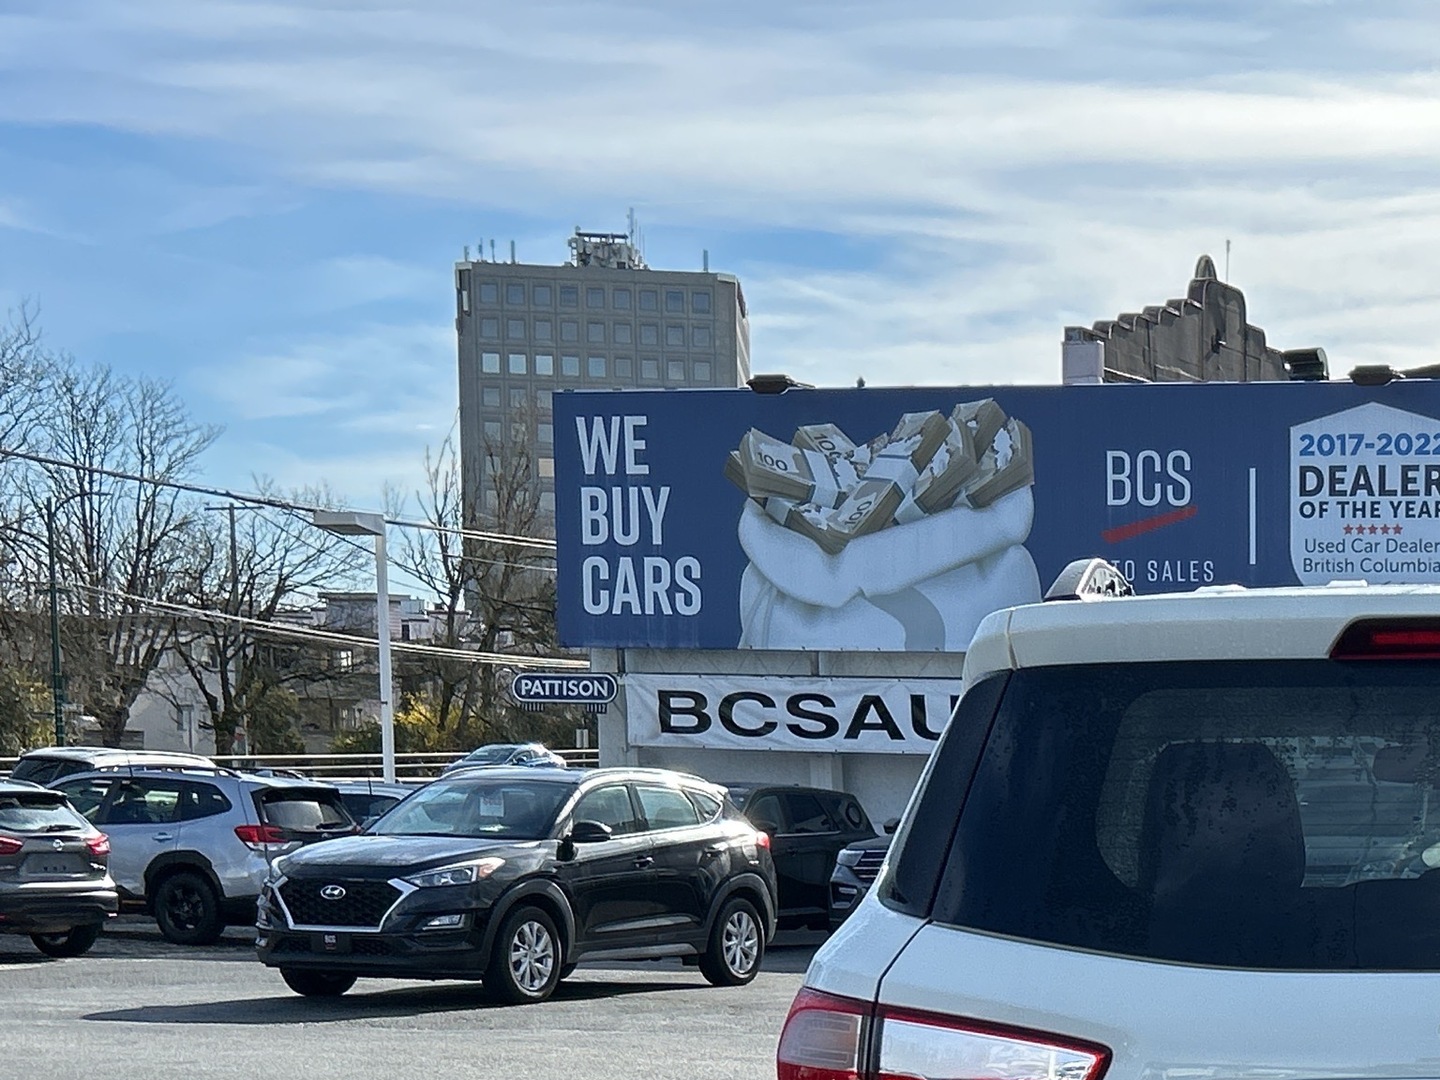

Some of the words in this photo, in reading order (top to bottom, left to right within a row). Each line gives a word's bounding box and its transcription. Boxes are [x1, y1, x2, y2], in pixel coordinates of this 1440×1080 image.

[575, 415, 649, 475] WE
[756, 450, 789, 472] 100
[1106, 449, 1192, 507] BCS
[580, 486, 671, 545] BUY
[844, 500, 873, 526] 100
[1299, 501, 1329, 519] OF
[1336, 501, 1381, 519] THE
[1304, 537, 1346, 554] Used
[1351, 537, 1381, 554] Car
[1386, 537, 1440, 554] Dealer
[1147, 560, 1214, 582] SALES
[1303, 557, 1354, 573] British
[582, 556, 702, 616] CARS
[521, 679, 608, 697] PATTISON
[658, 690, 960, 741] BCSAU
